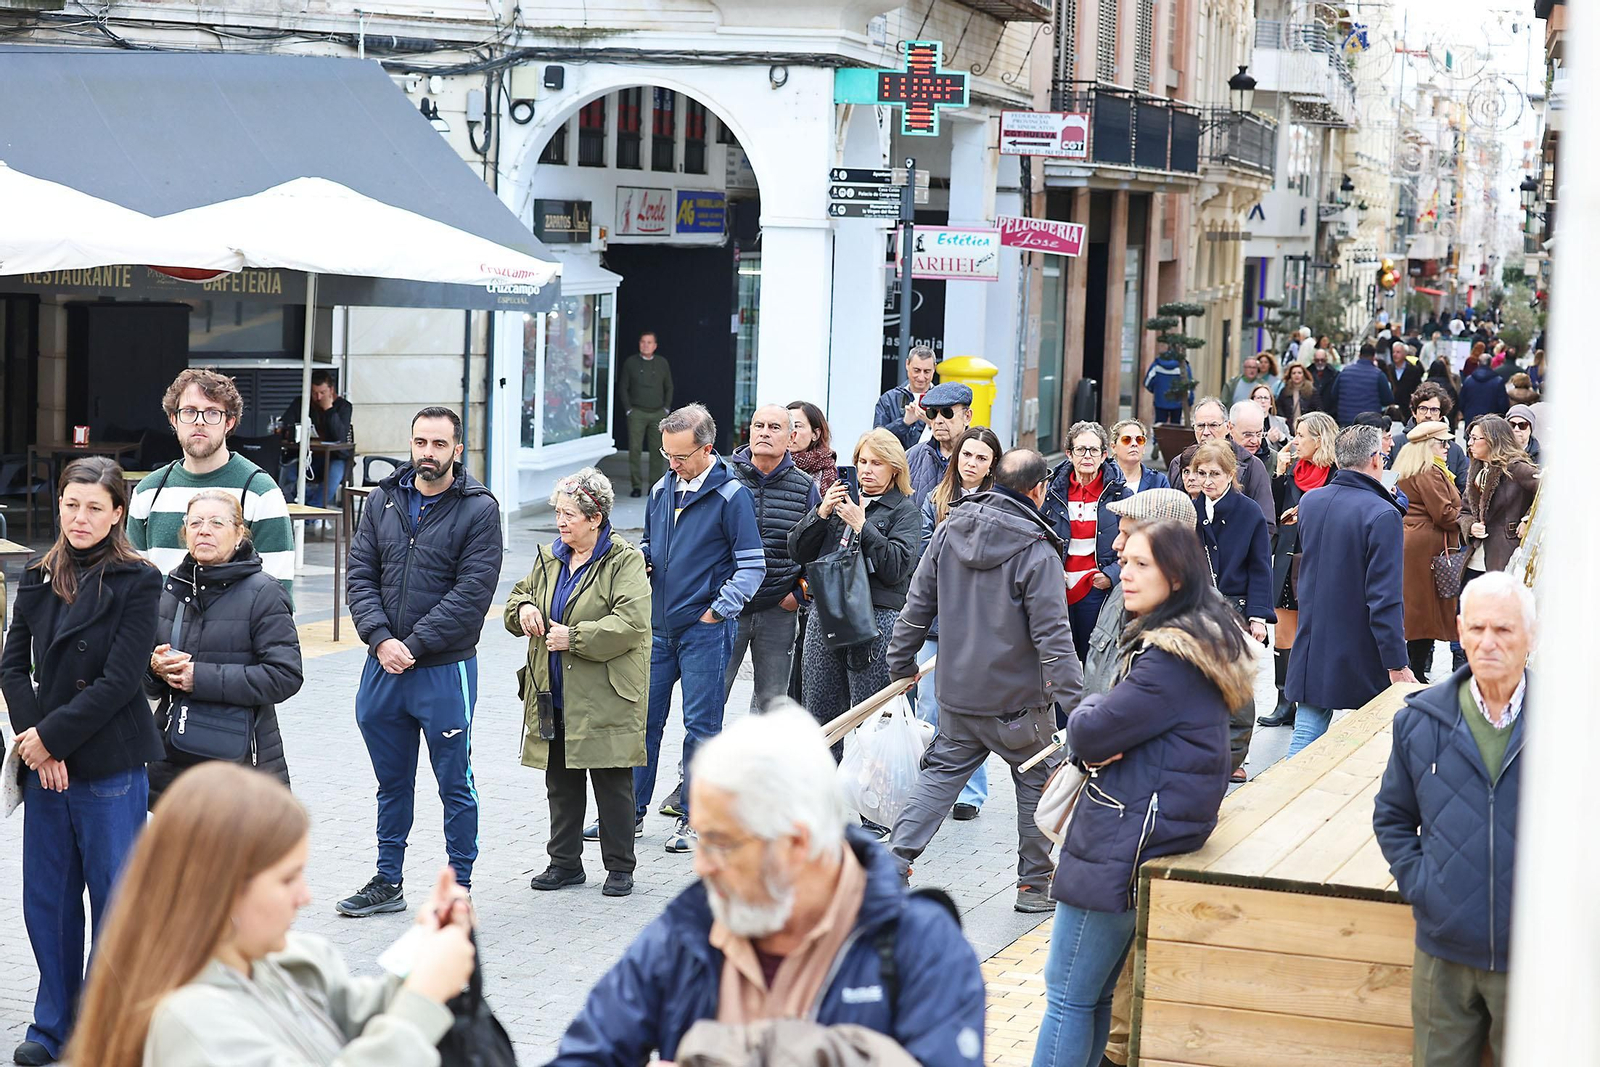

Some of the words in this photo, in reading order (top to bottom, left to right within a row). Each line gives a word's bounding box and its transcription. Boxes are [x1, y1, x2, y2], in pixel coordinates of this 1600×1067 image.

[1062, 140, 1084, 151] CGT
[676, 199, 695, 226] AG
[545, 214, 572, 229] ZAPATOS
[937, 231, 990, 247] Estética
[998, 218, 1080, 247] PELUQUERIA
[24, 265, 131, 288] RESTAURANTE
[480, 263, 540, 279] Cruzcamp
[486, 284, 541, 297] Cruzcampo
